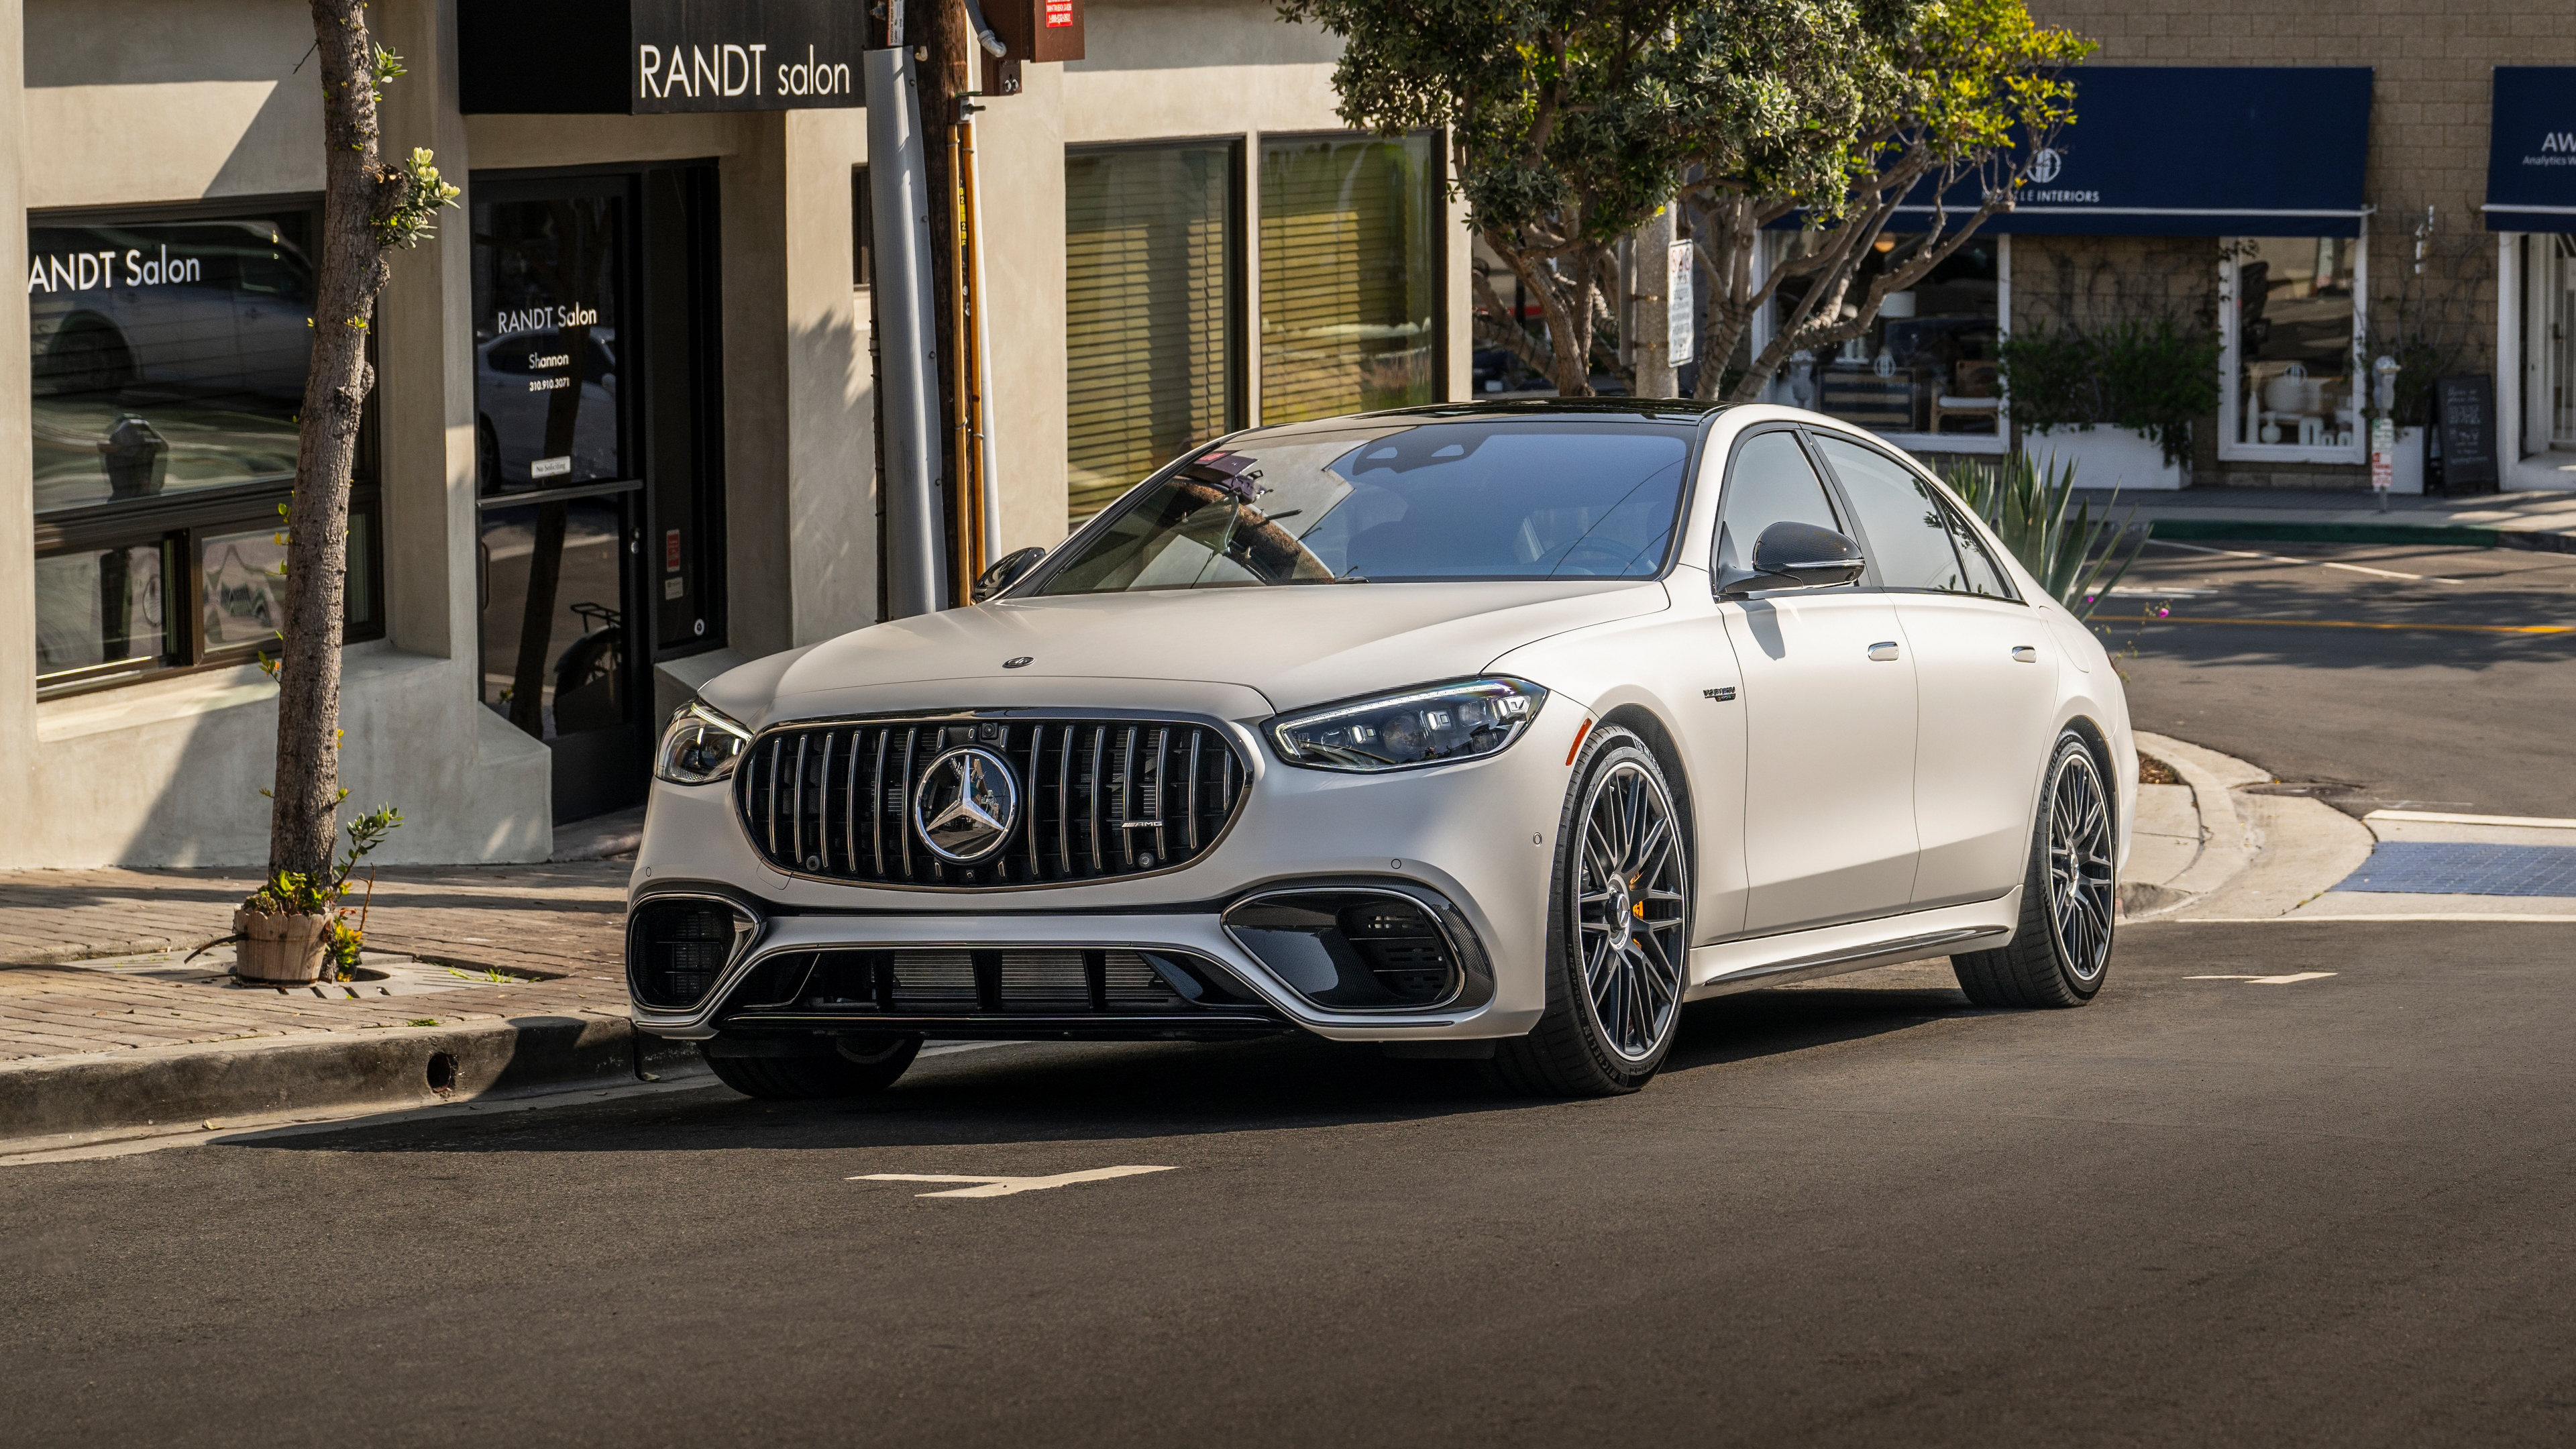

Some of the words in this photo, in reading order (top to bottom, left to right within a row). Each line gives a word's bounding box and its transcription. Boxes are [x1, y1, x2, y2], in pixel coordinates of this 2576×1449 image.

[640, 44, 767, 99] RANDT
[777, 44, 851, 96] salon
[2037, 189, 2100, 203] INTERIORS
[126, 244, 201, 287] Salon
[498, 306, 553, 334] RANDT
[557, 301, 598, 328] Salon
[529, 352, 570, 370] Shannon
[529, 376, 570, 392] 310.910.3071
[1583, 1023, 1617, 1079] MICHELIN
